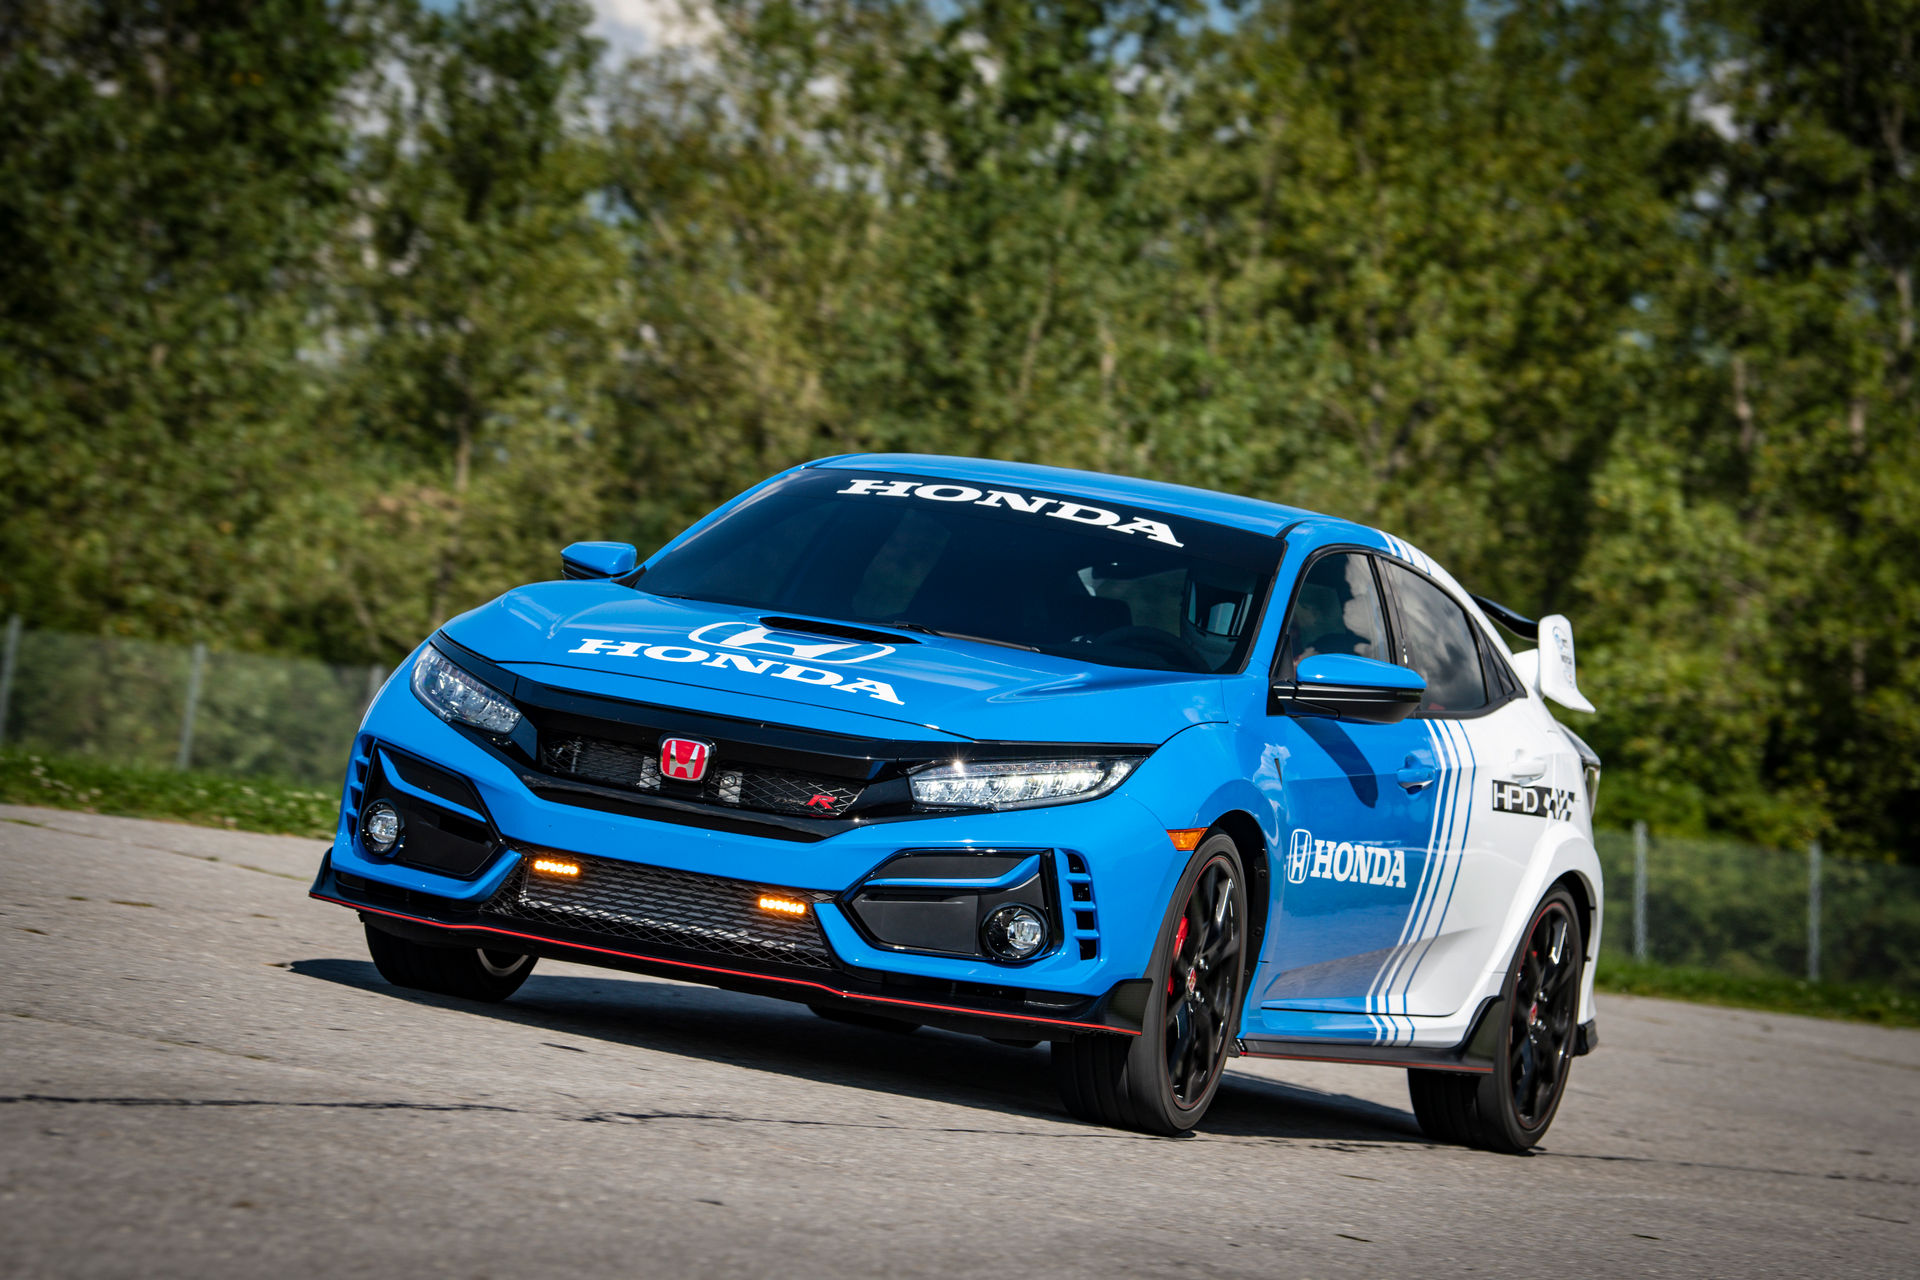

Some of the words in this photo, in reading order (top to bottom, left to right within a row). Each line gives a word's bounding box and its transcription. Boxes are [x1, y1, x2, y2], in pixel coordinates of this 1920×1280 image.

[836, 479, 1185, 548] HONDA
[567, 638, 906, 706] HONDA
[1492, 782, 1539, 813] HPD
[1310, 839, 1407, 889] HONDA
